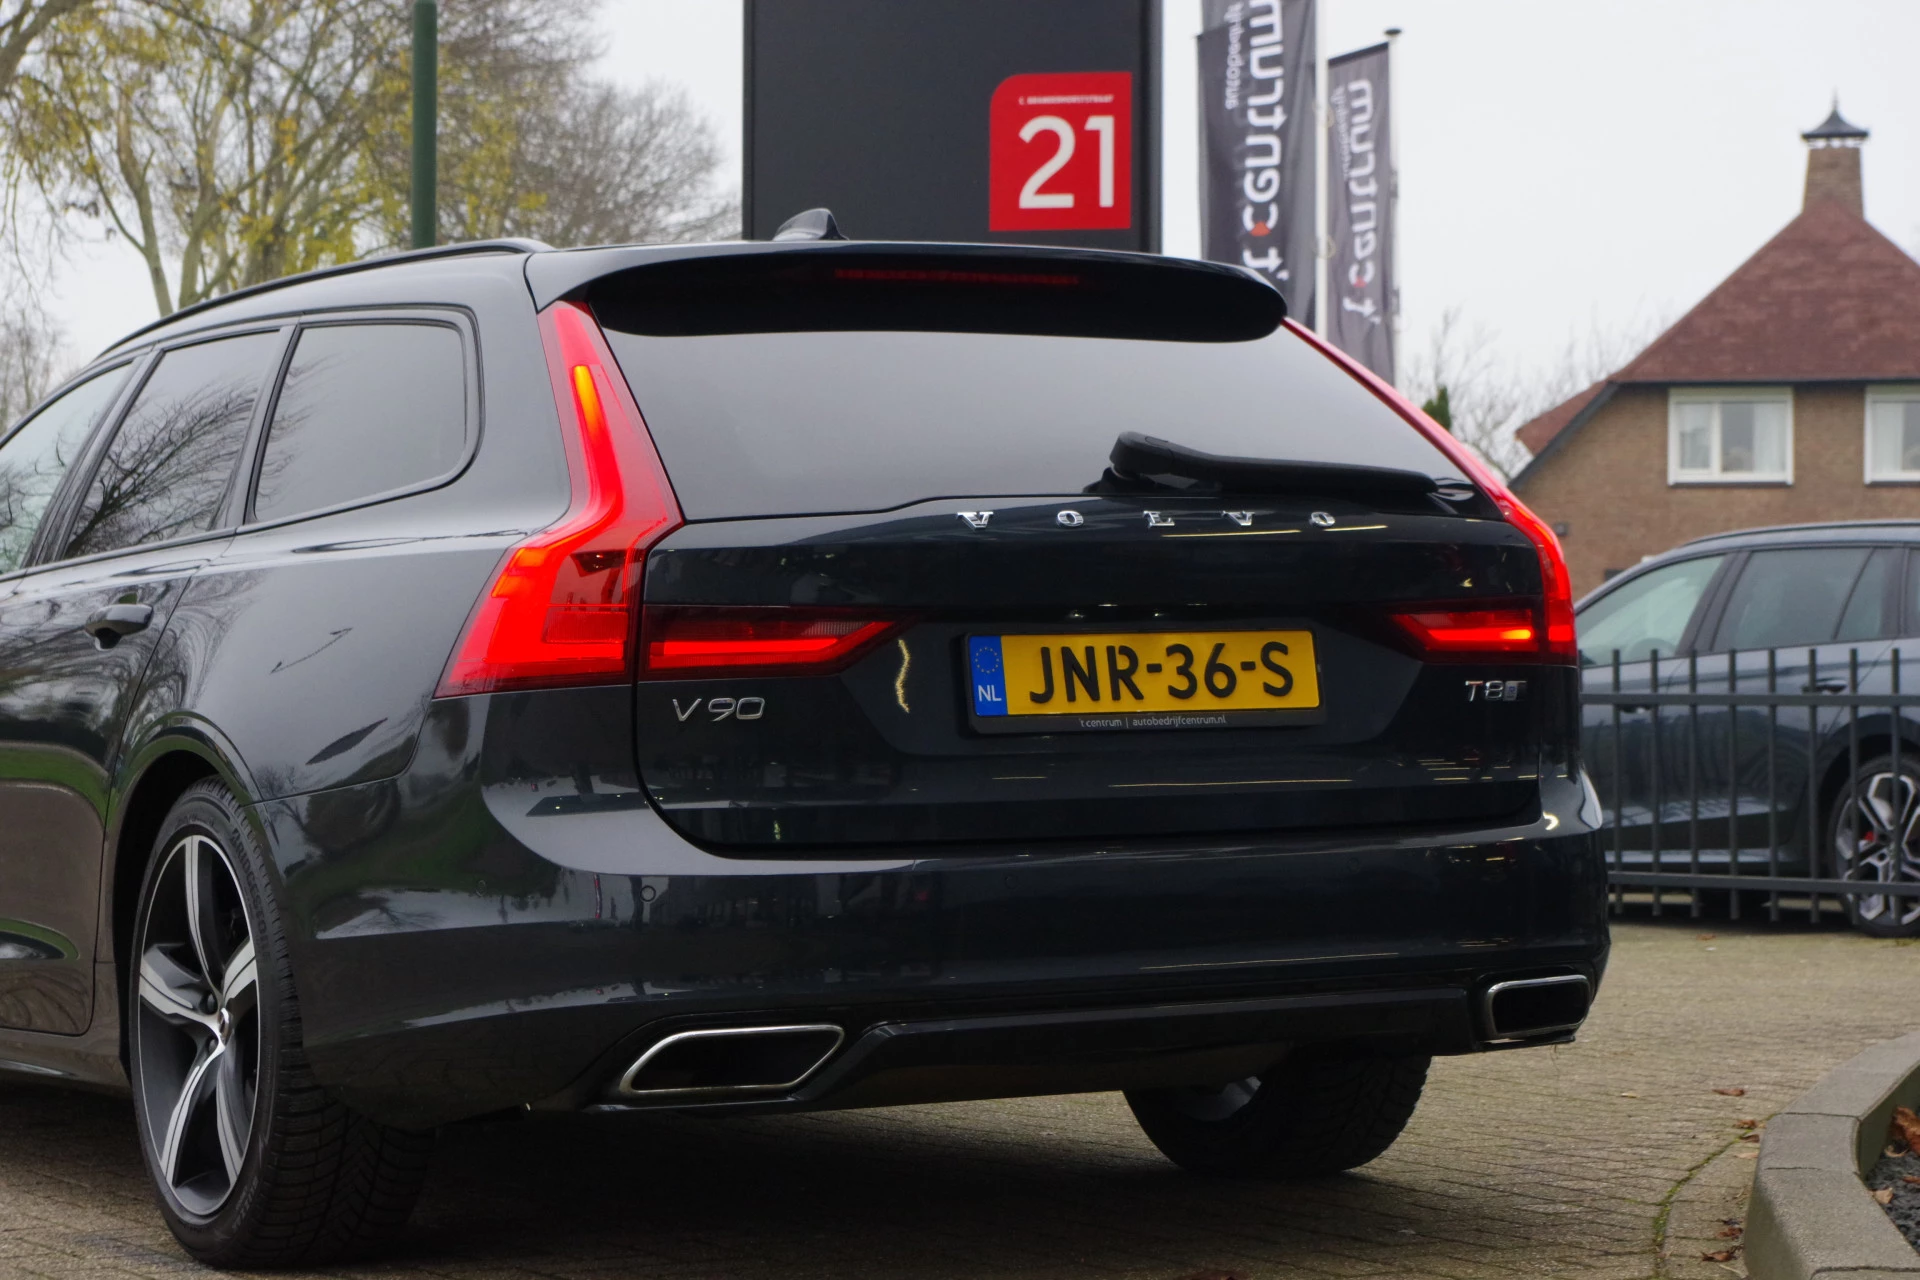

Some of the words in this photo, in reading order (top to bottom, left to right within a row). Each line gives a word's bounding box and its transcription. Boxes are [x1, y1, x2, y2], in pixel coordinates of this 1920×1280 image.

[1018, 115, 1114, 209] 21
[956, 509, 1336, 530] VOLVO
[1029, 641, 1294, 704] JNR-36-S
[977, 685, 1002, 702] NL
[1086, 717, 1122, 728] centrum
[1132, 715, 1227, 728] autobedrijfcentrum.nl
